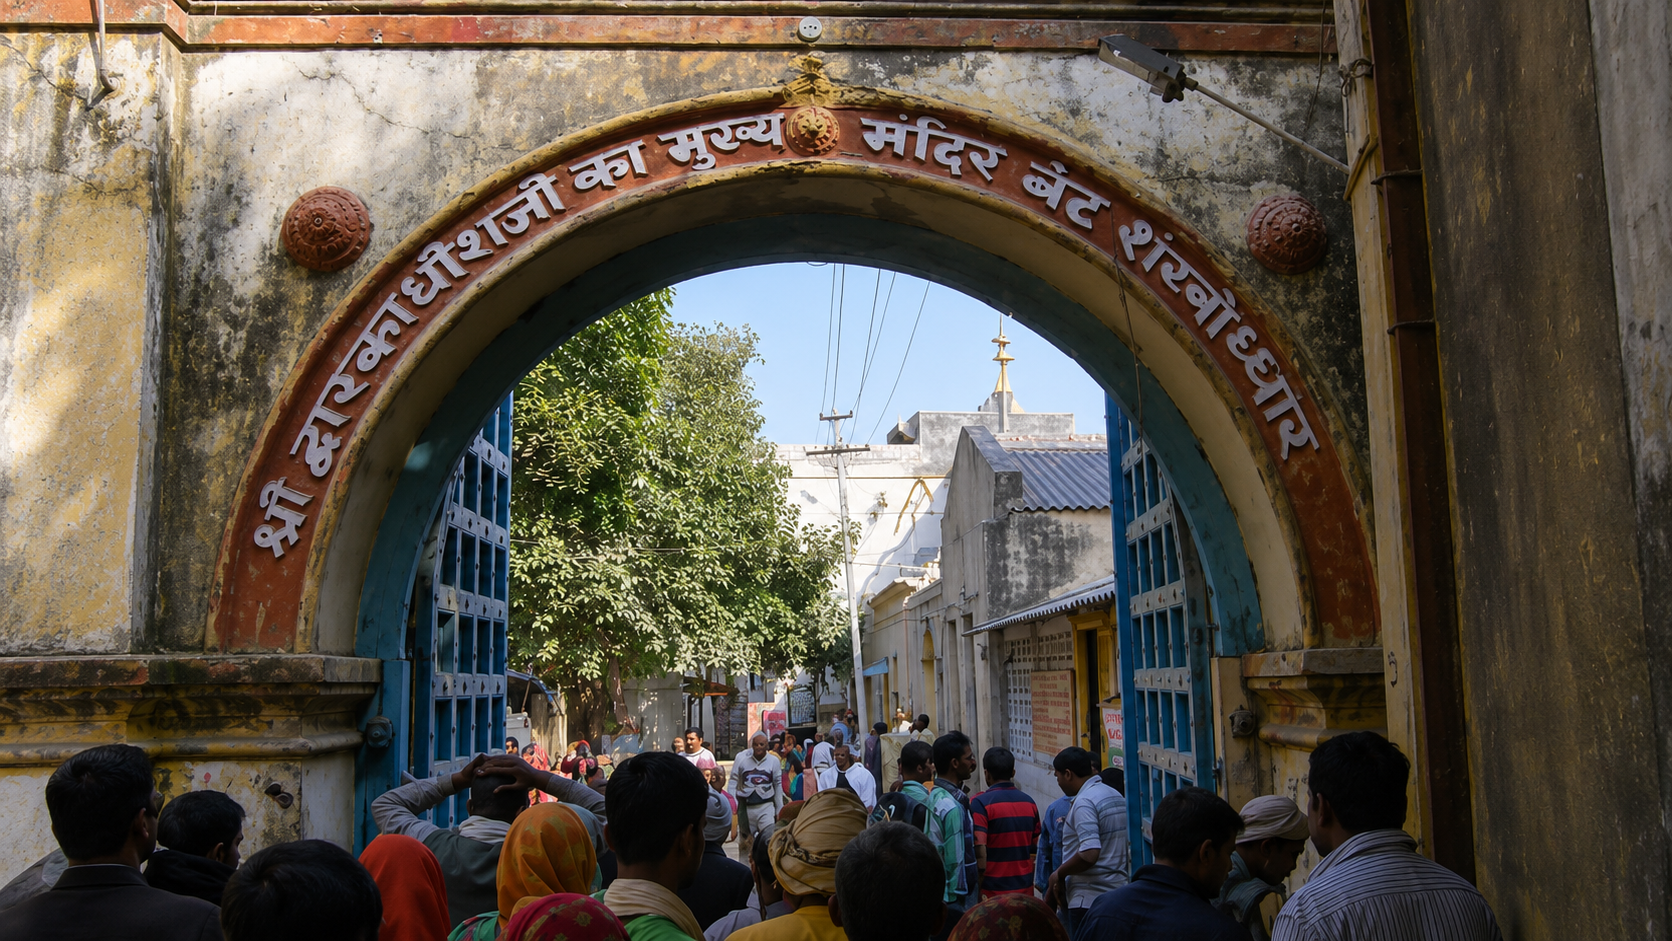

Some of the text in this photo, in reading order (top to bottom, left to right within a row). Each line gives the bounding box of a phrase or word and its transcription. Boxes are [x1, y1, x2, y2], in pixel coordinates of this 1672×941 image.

[253, 476, 313, 558] श्री
[569, 139, 648, 190] का
[659, 112, 786, 172] मुख्य
[861, 114, 1008, 182] मंदिर
